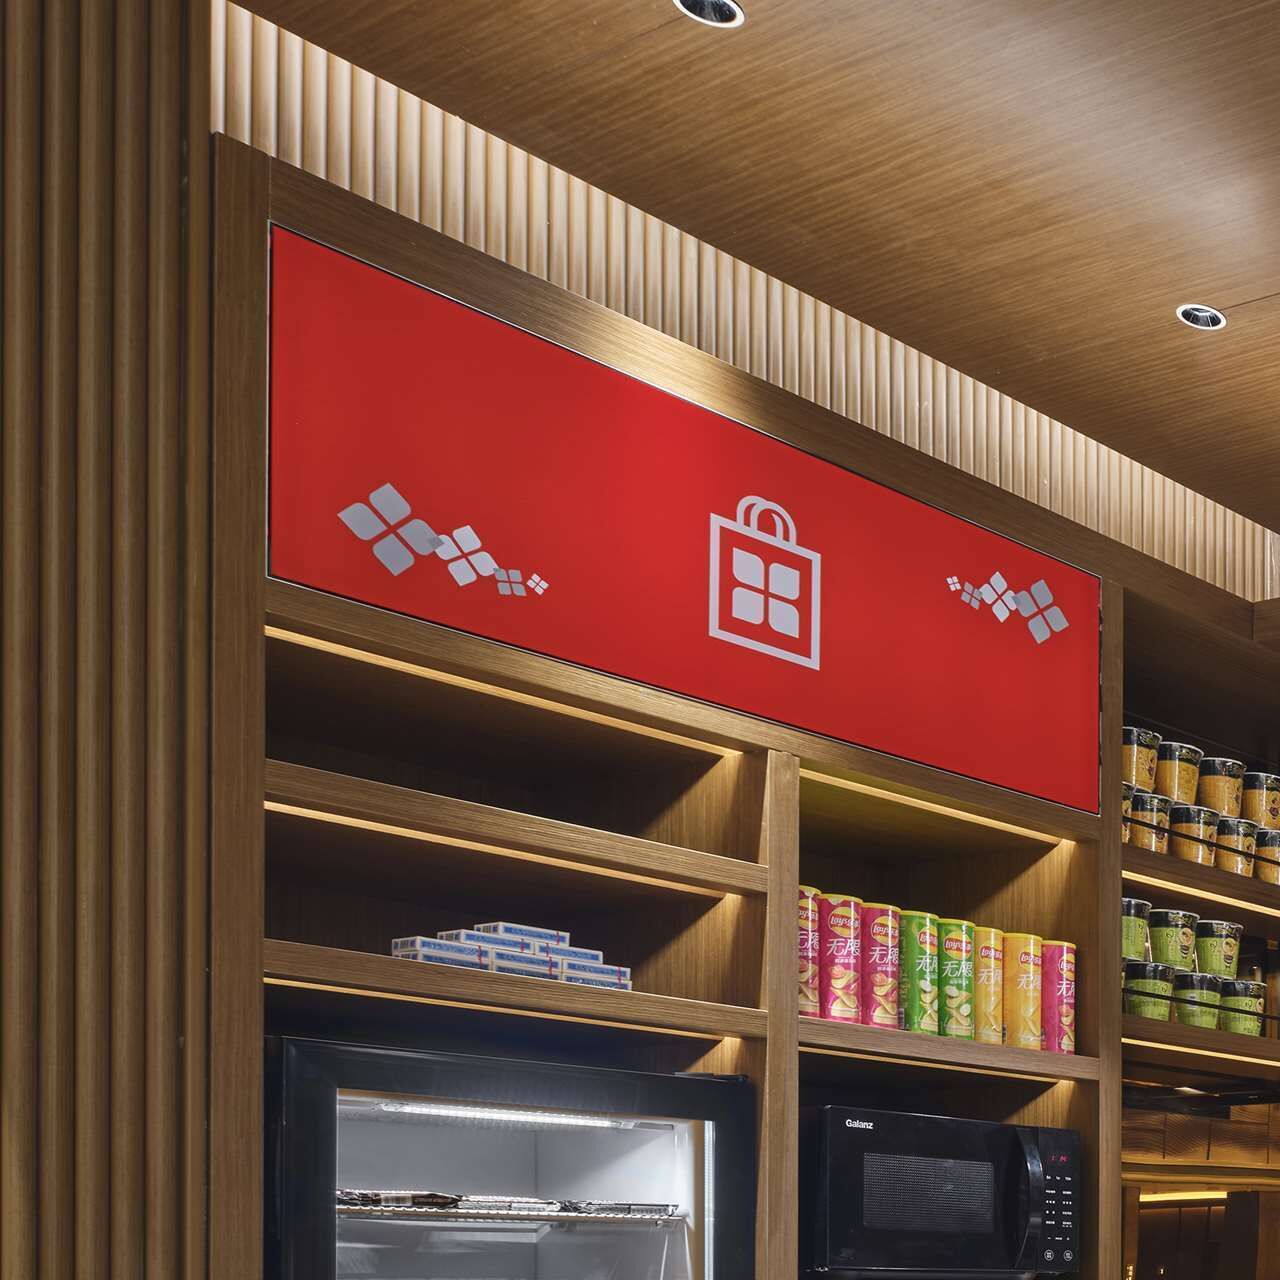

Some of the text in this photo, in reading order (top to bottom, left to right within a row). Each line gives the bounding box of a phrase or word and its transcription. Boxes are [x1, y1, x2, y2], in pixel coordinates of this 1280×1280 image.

[827, 938, 861, 956] 无限
[869, 946, 899, 964] 无限
[943, 960, 974, 978] 无限
[845, 1118, 874, 1130] Galanz
